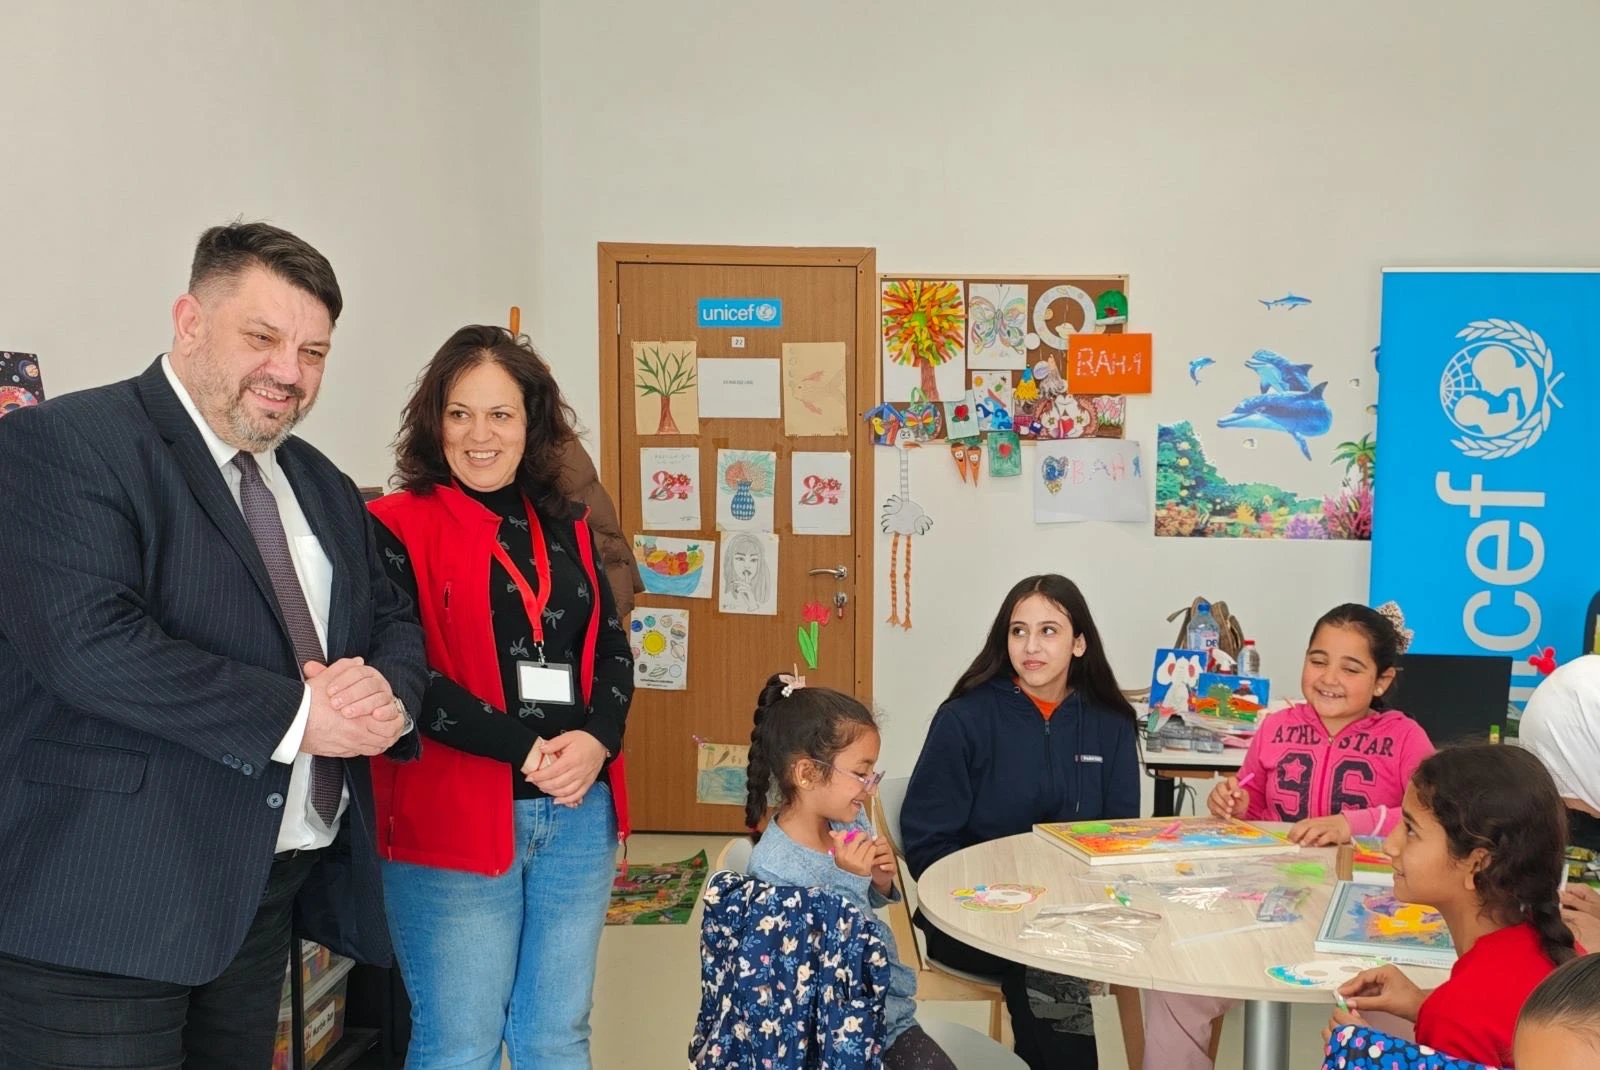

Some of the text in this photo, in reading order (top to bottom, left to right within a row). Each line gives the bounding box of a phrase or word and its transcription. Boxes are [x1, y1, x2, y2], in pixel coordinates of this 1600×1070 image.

[702, 304, 755, 321] unicef
[1338, 732, 1394, 757] STAR
[1274, 752, 1374, 823] 96
